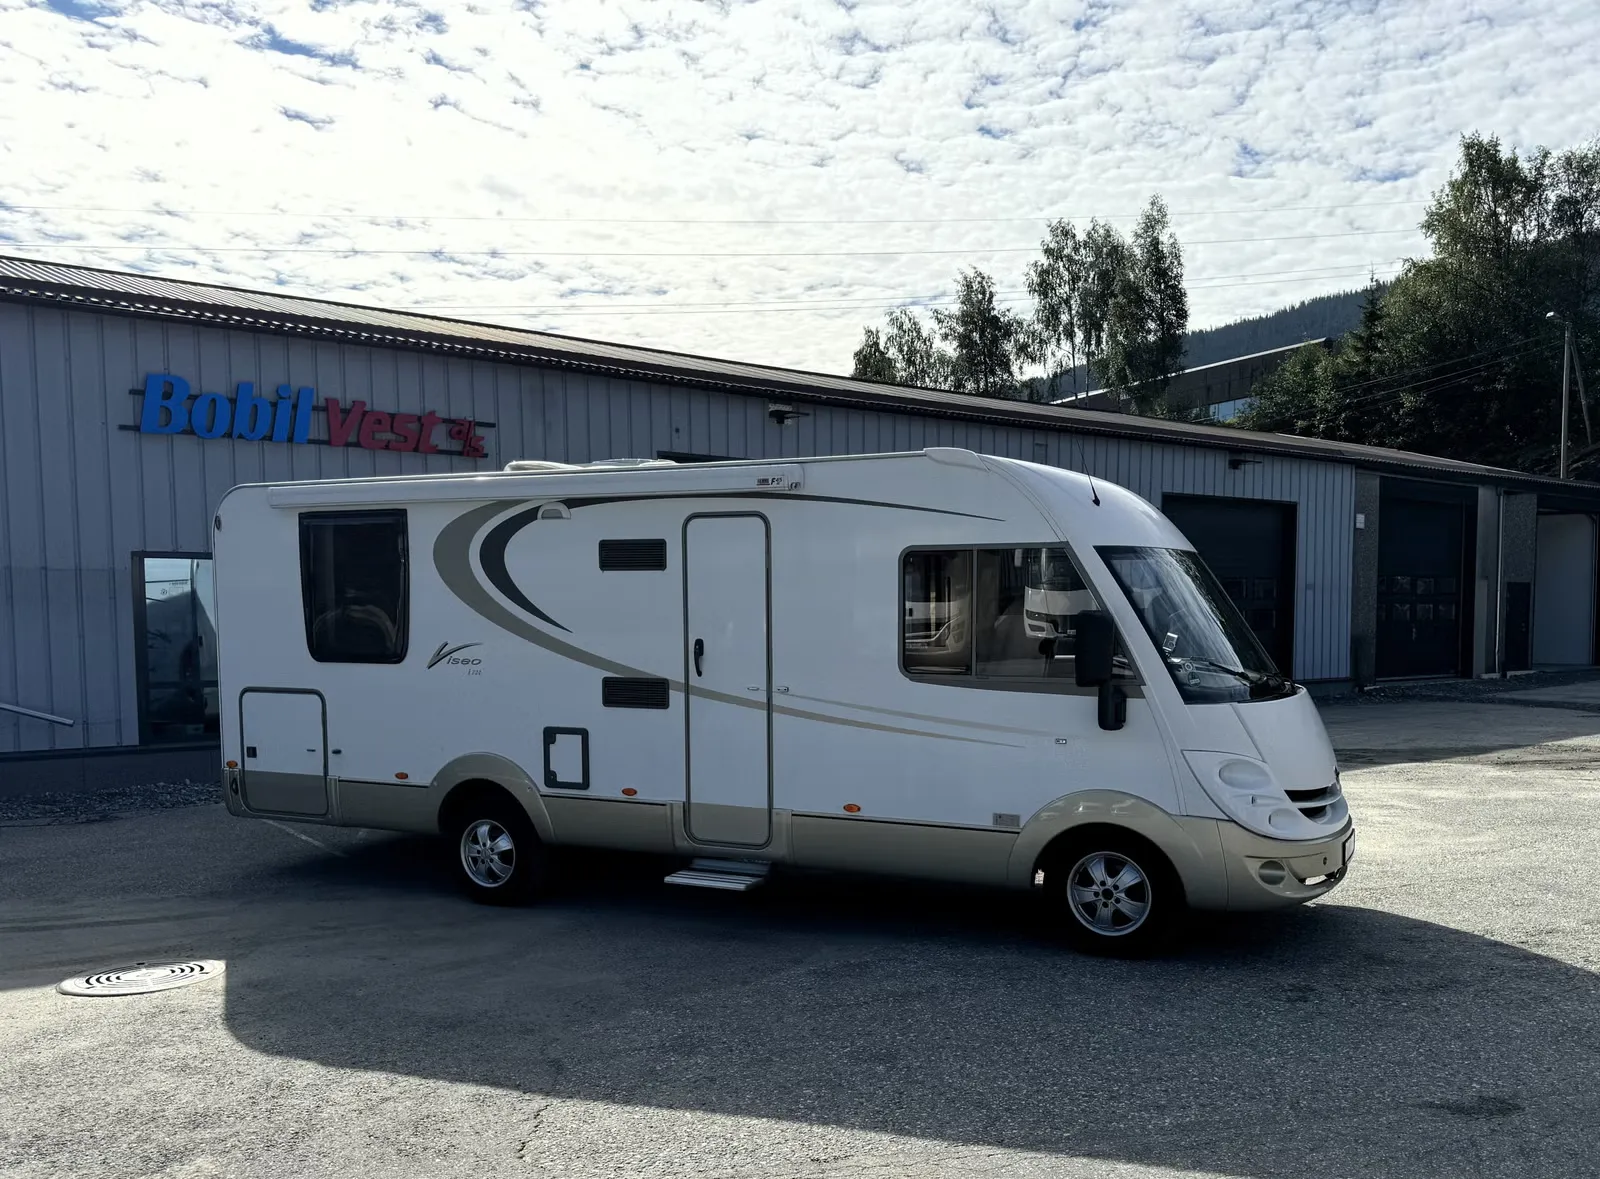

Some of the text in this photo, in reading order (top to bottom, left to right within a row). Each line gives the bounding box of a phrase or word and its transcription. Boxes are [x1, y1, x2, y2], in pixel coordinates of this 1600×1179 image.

[140, 373, 314, 444] Bobil
[324, 397, 444, 454] Vest
[426, 640, 484, 670] Viseo
